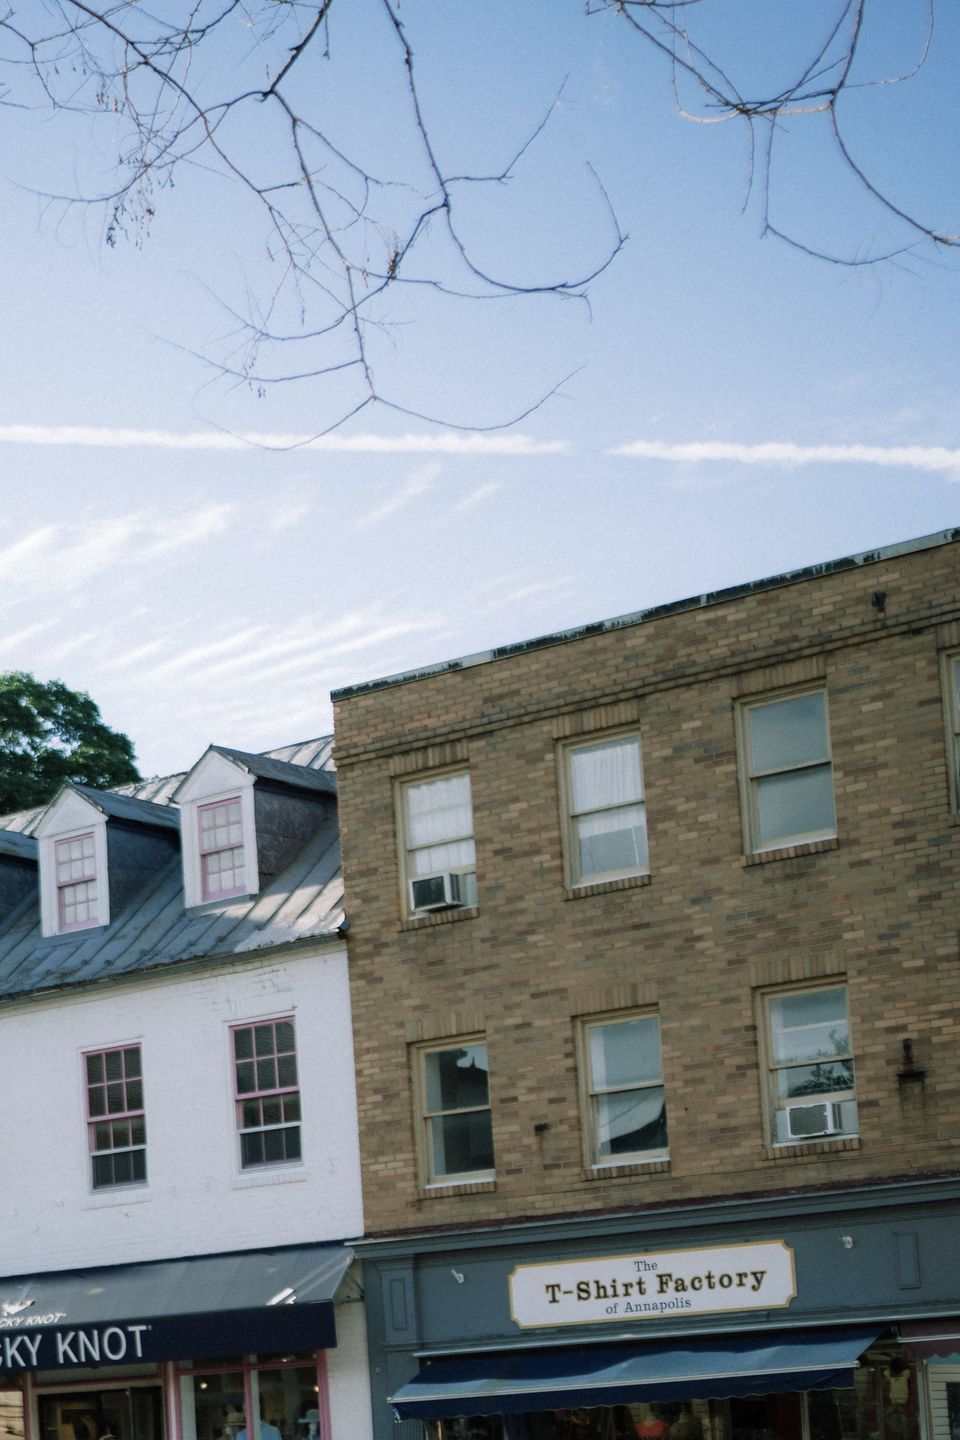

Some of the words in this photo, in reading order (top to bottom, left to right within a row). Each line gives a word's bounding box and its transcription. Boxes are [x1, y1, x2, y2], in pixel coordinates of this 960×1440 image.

[634, 1260, 658, 1272] The
[545, 1276, 647, 1304] T-Shirt
[656, 1269, 768, 1293] Factory
[606, 1303, 619, 1315] of
[625, 1297, 692, 1314] Annapolis
[55, 1325, 147, 1364] KNOT
